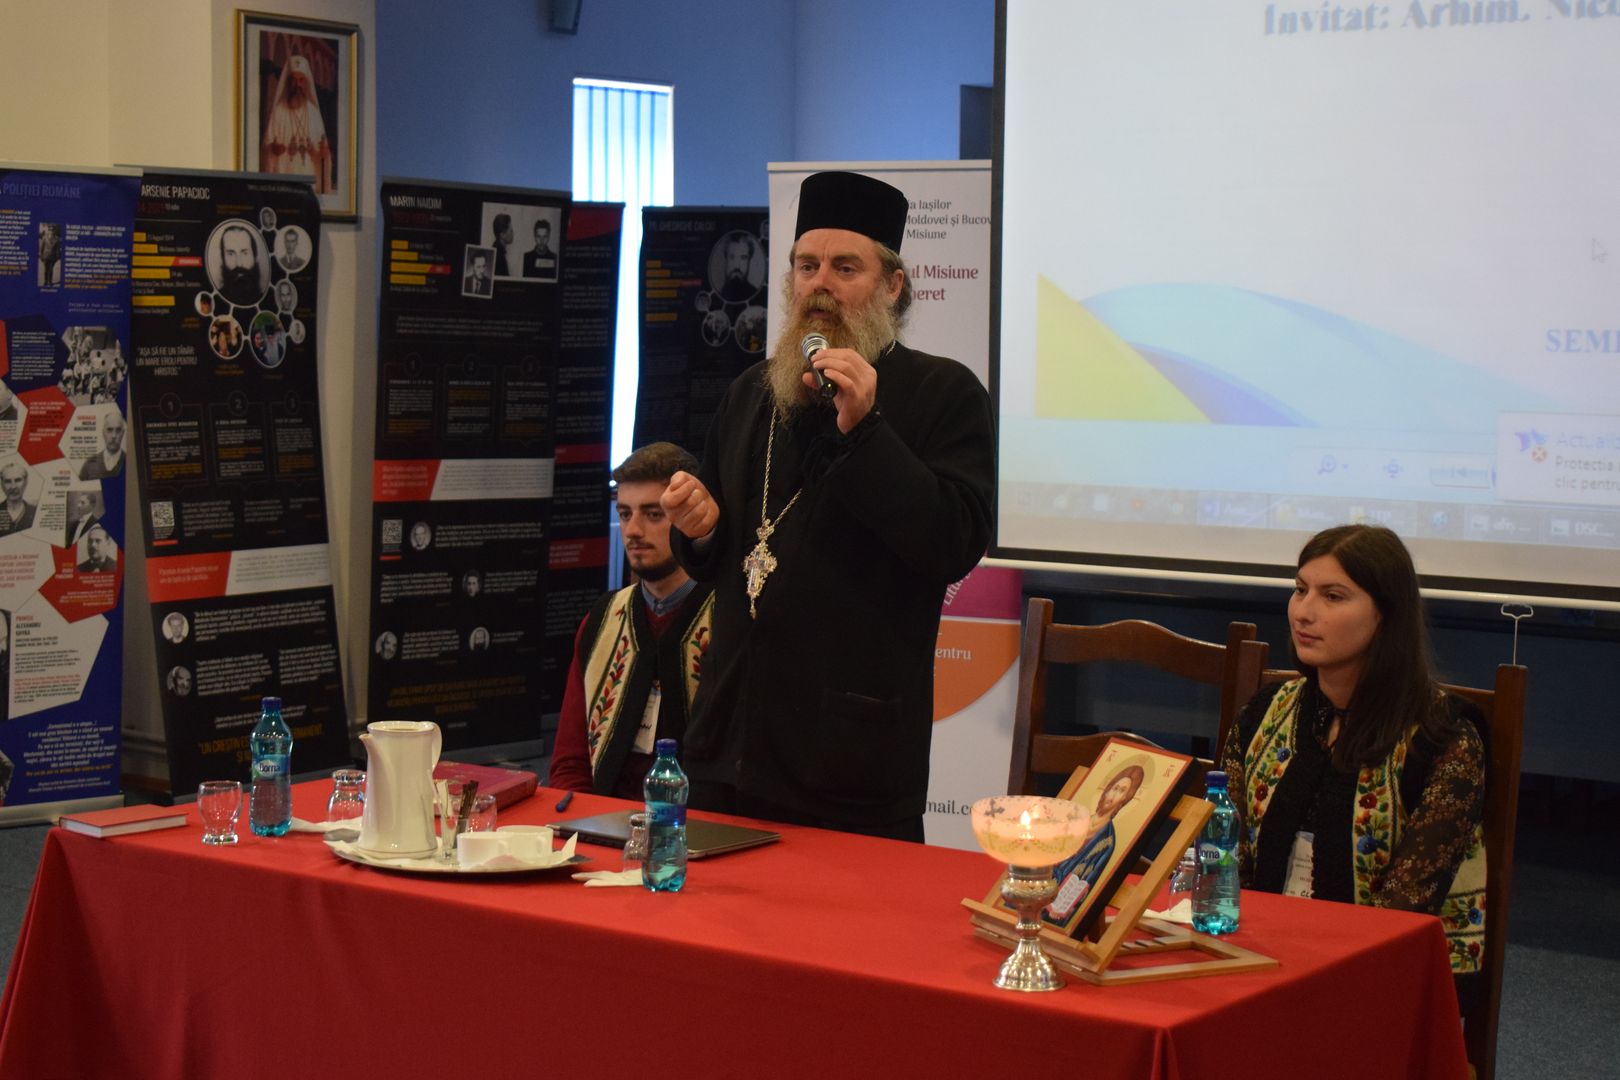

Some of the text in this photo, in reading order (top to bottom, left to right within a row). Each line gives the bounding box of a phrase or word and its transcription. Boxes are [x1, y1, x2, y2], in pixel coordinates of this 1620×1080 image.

[1264, 1, 1390, 35] Invitat:
[1400, 0, 1530, 28] Arhim.
[141, 185, 210, 200] ARSENIE PAPACIOC
[389, 195, 416, 208] MARIN
[919, 199, 952, 212] Iașilor
[951, 214, 960, 227] și
[906, 229, 947, 239] Misiune
[923, 264, 979, 279] Misiune
[235, 399, 242, 409] 2
[1555, 476, 1577, 489] clic
[934, 648, 972, 660] entru
[260, 762, 280, 773] Dorna
